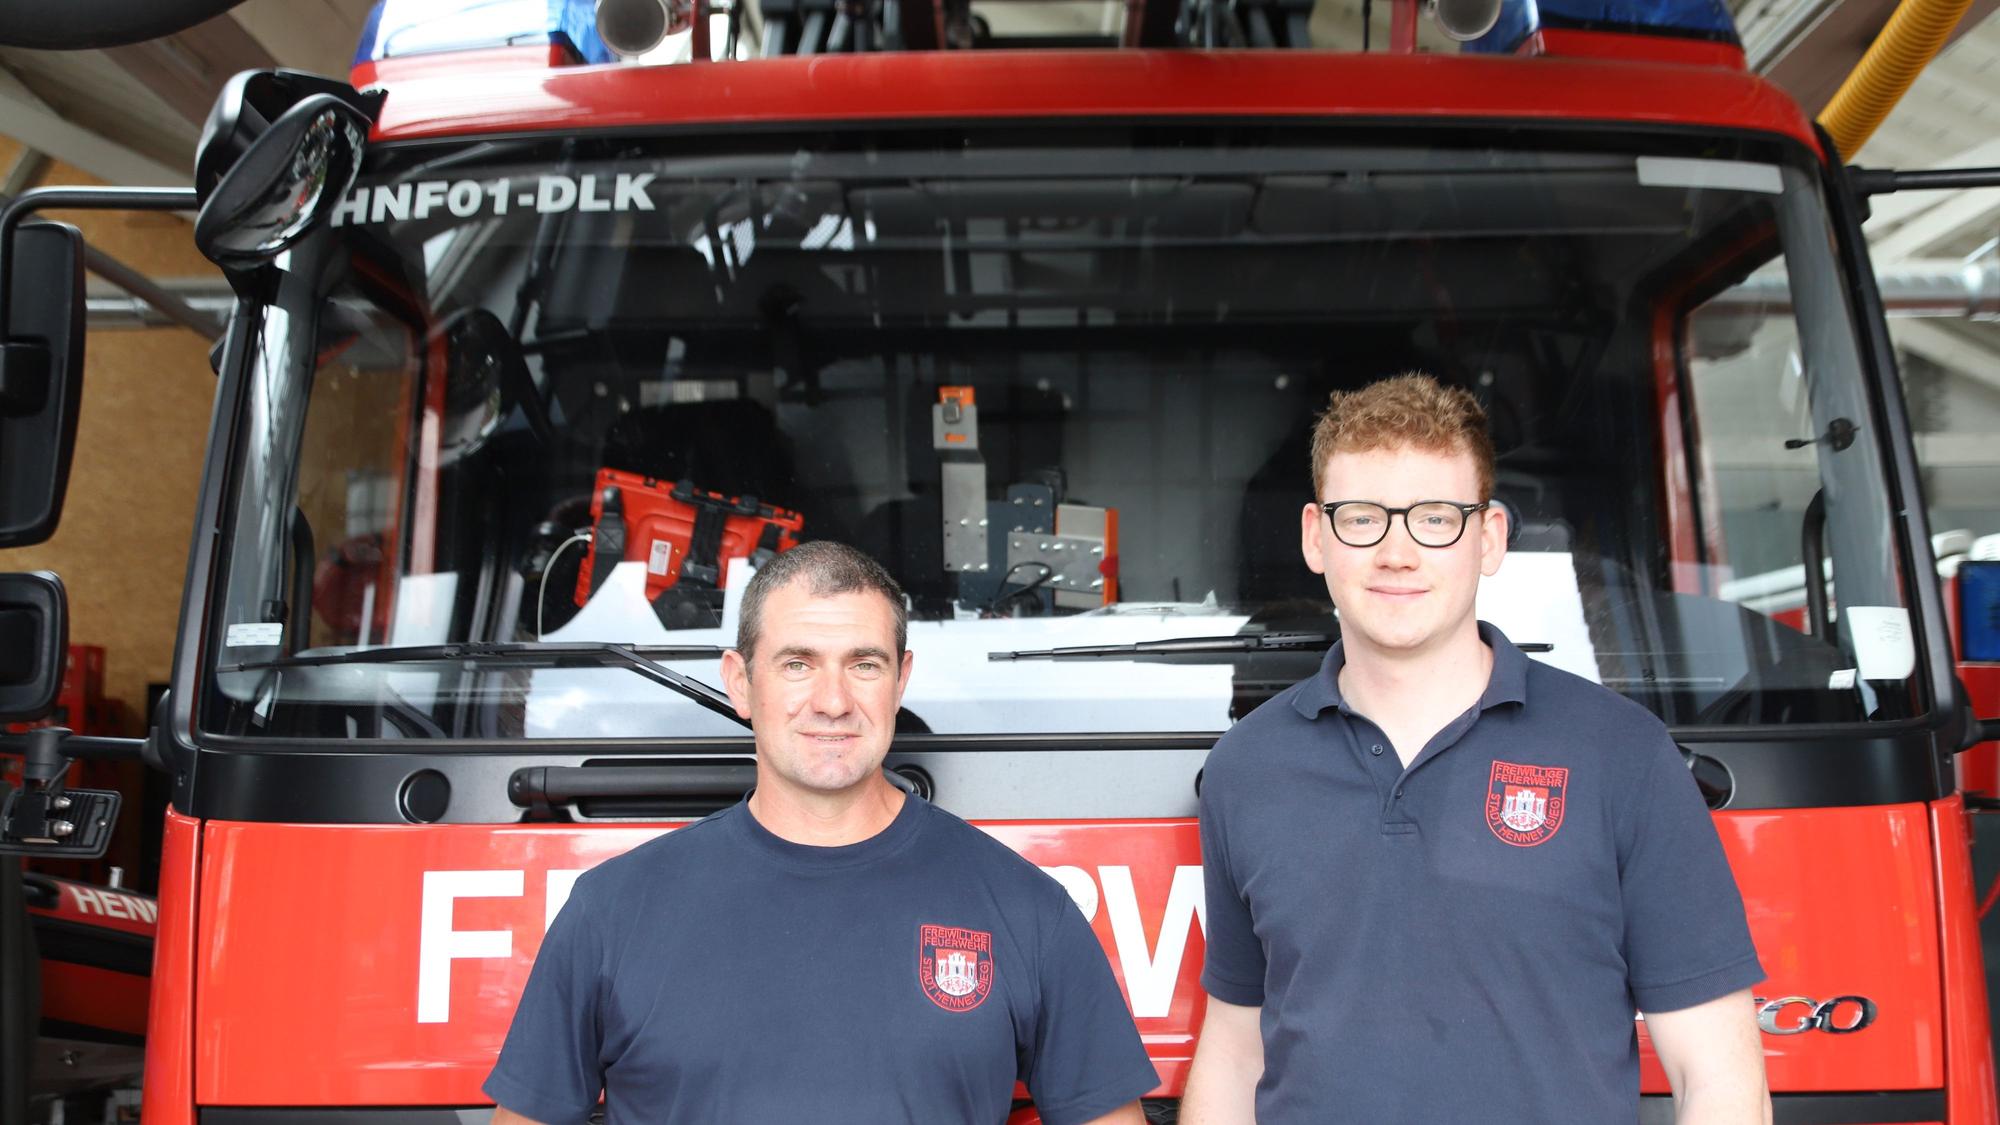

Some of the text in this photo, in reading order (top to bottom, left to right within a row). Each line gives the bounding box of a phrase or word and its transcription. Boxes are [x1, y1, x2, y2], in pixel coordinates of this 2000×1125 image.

[1495, 764, 1565, 779] FREIWILLIGE
[1494, 773, 1563, 788] FEUERWEHR
[1488, 793, 1504, 827] STADT
[1498, 825, 1545, 843] HENNEF
[924, 927, 988, 944] FREIWILLIGE
[924, 937, 988, 953] FEUERWEHR
[923, 957, 938, 991] STADT
[934, 990, 978, 1008] HENNEF
